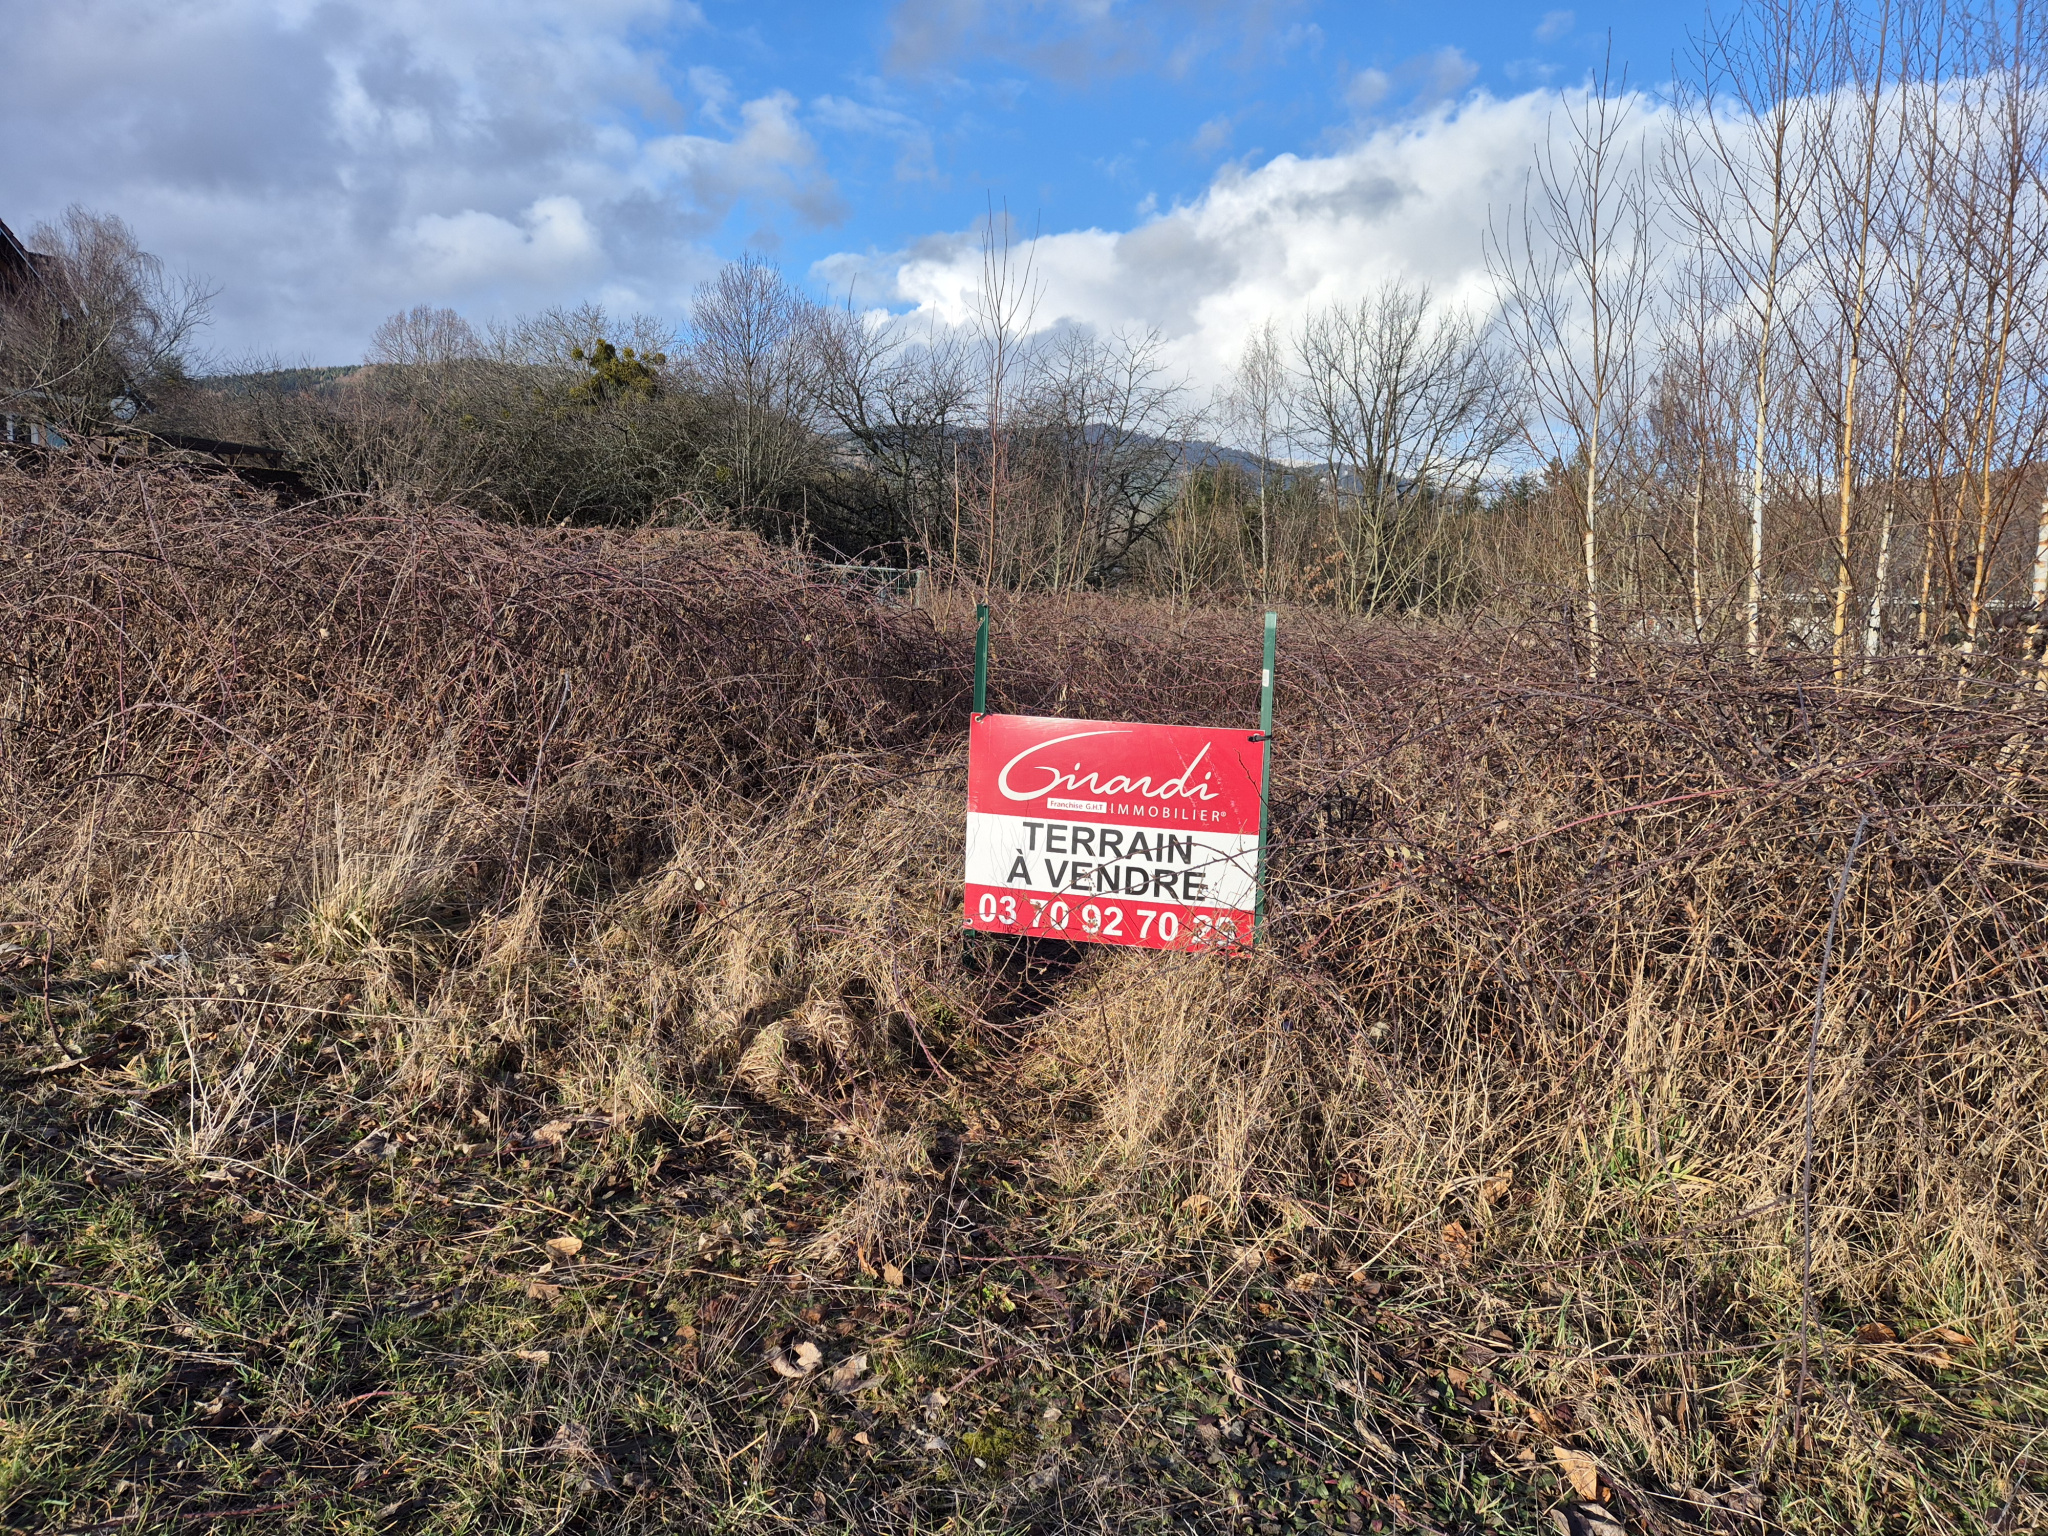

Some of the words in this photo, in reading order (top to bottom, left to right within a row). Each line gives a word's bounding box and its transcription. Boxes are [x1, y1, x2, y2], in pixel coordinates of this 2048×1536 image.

[998, 730, 1220, 801] Girardi
[1050, 800, 1083, 810] Franchise
[1022, 821, 1193, 864] TERRAIN
[1006, 848, 1032, 885] À
[1044, 858, 1209, 902] VENDRE
[978, 893, 1017, 925] 03
[1029, 898, 1070, 931] 70
[1081, 902, 1124, 937] 92
[1136, 909, 1179, 941] 70
